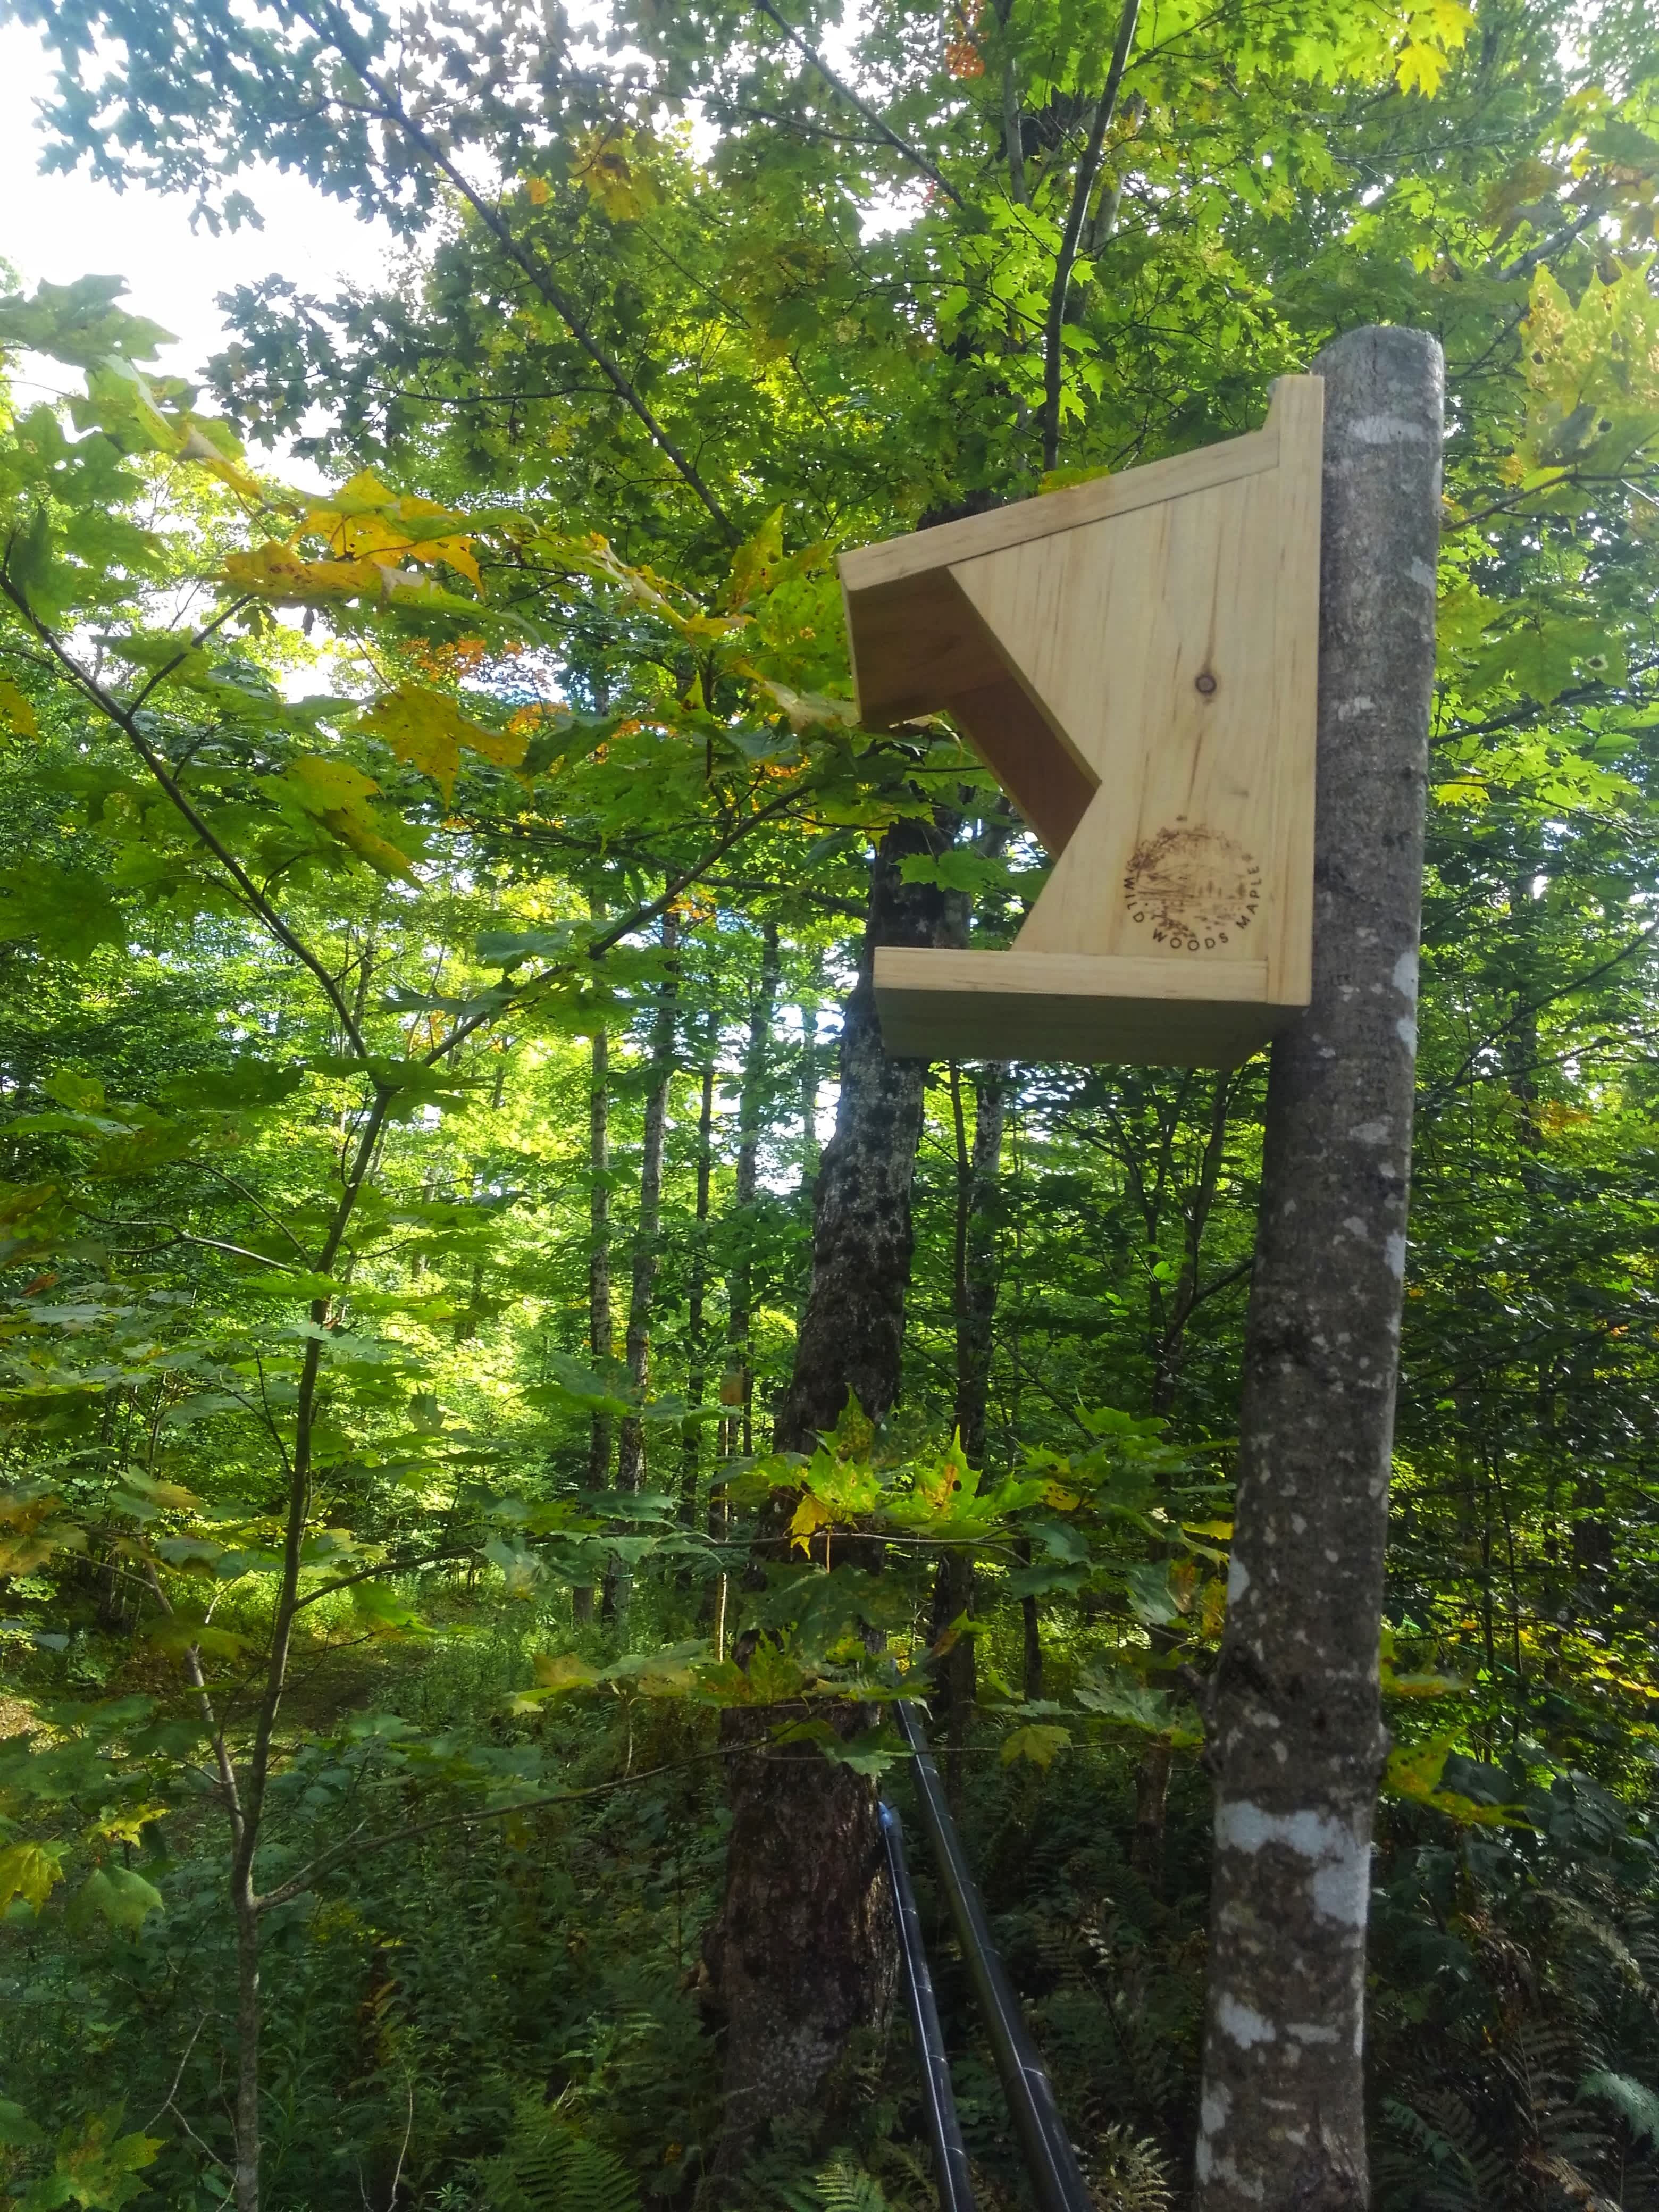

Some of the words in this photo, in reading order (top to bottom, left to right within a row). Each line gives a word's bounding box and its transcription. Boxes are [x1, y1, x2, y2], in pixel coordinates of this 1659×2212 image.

[1124, 877, 1145, 923] WILD
[1153, 928, 1228, 951] WOODS
[1236, 866, 1262, 929] MAPLE
